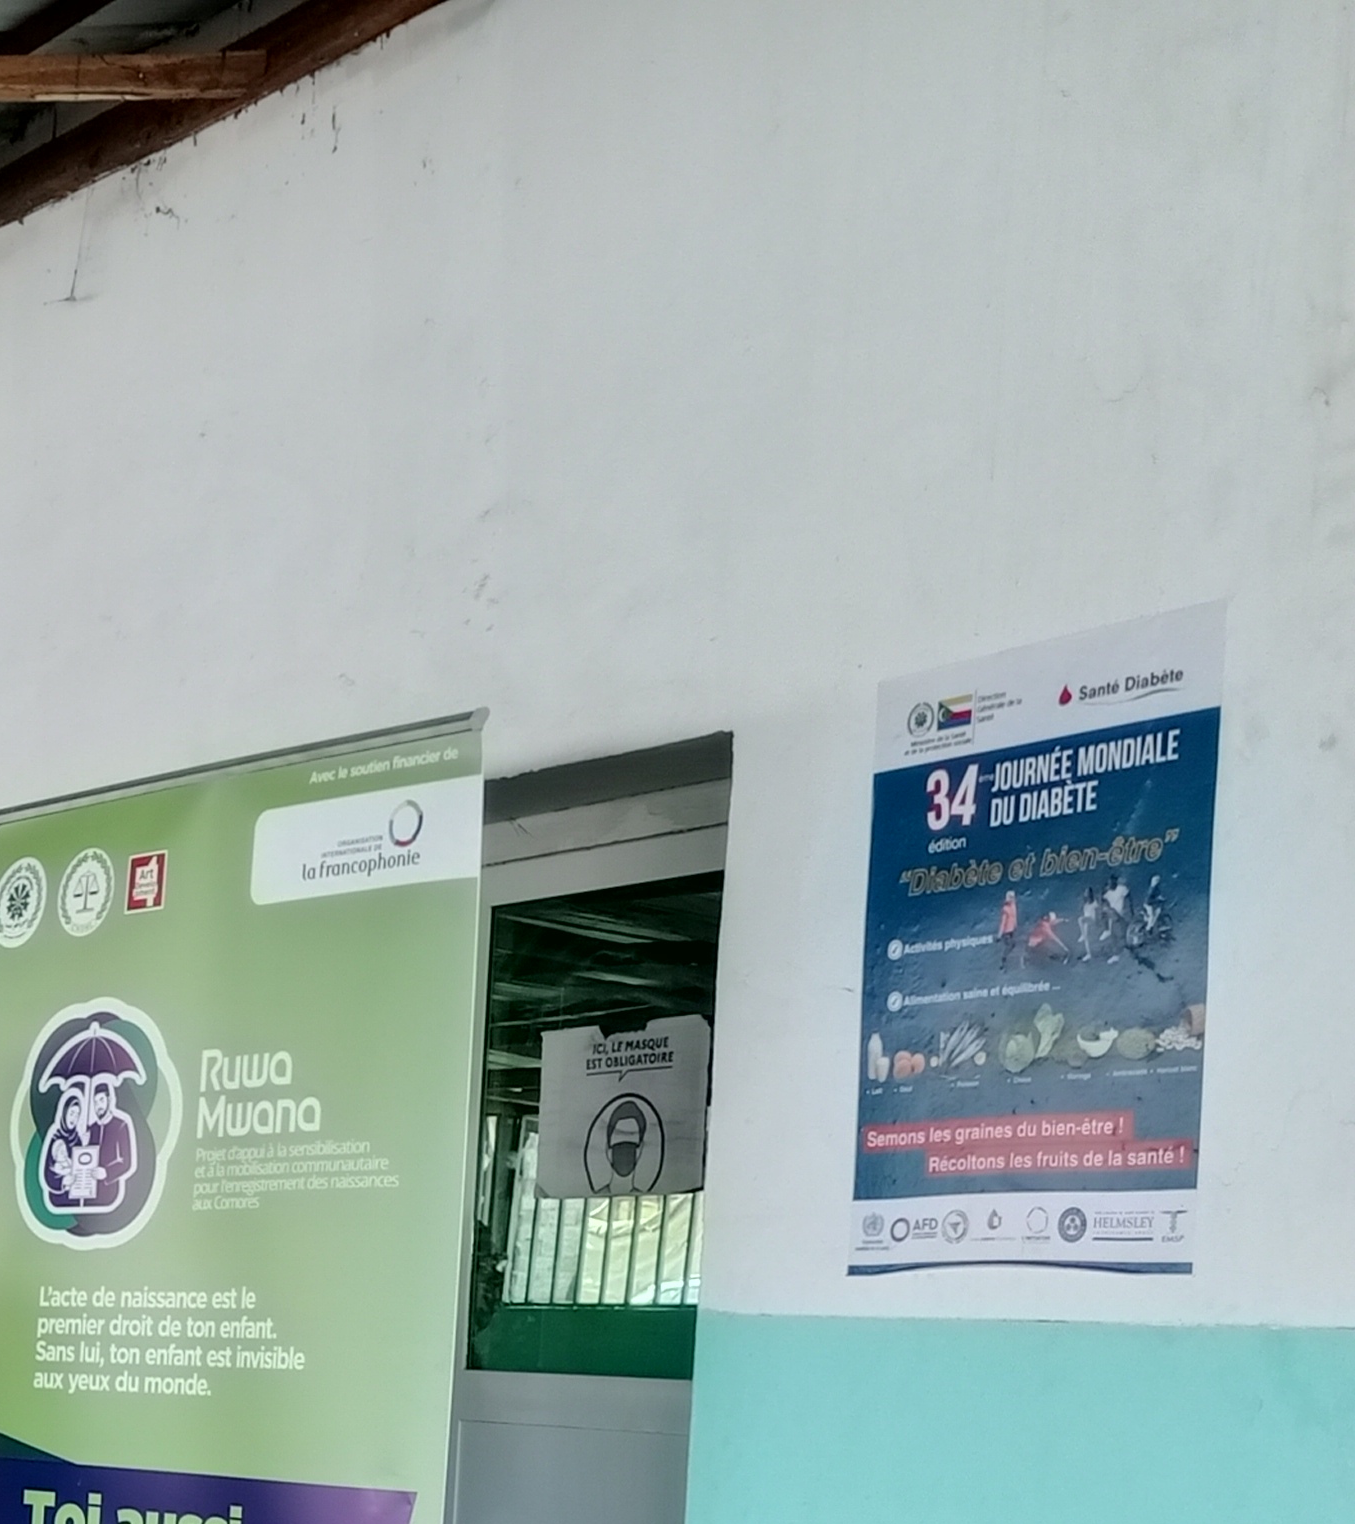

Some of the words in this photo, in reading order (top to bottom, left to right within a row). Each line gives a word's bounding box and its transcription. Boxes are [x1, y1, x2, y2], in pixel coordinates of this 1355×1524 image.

[1078, 680, 1120, 701] Santé
[1124, 668, 1185, 692] Diabète
[309, 770, 335, 785] Avec
[338, 766, 348, 779] le
[350, 759, 390, 778] soutien
[393, 750, 441, 769] financier
[443, 747, 459, 761] de
[925, 764, 979, 831] 34
[991, 745, 1074, 793] JOURNÉE
[1077, 729, 1181, 777] MONDIALE
[990, 796, 1016, 827] DU
[1018, 780, 1099, 823] DIABÈTE
[928, 836, 967, 854] édition
[139, 869, 154, 879] Art
[302, 863, 316, 881] la
[319, 849, 421, 877] francophonie
[1008, 852, 1035, 881] et
[903, 940, 942, 955] Activités
[944, 934, 993, 951] physiques
[903, 990, 961, 1006] Alimentation
[963, 988, 989, 1000] saine
[990, 986, 999, 997] et
[1001, 981, 1050, 997] équilibrée
[592, 1042, 609, 1055] ICI,
[611, 1040, 624, 1053] LE
[625, 1036, 669, 1051] MASQUE
[199, 1048, 293, 1093] Ruwa
[586, 1058, 602, 1070] EST
[605, 1051, 674, 1068] OBLIGATOIRE
[196, 1094, 322, 1139] Mwana
[867, 1131, 925, 1147] Semons
[929, 1127, 951, 1142] les
[955, 1123, 1012, 1145] graines
[1017, 1121, 1036, 1137] du
[1042, 1118, 1114, 1136] bien-être
[195, 1147, 226, 1165] Projet
[267, 1143, 274, 1158] à
[277, 1142, 287, 1157] la
[289, 1139, 370, 1157] sensibilisation
[929, 1153, 1005, 1173] Récoltons
[1010, 1152, 1032, 1168] les
[1037, 1150, 1078, 1167] fruits
[1083, 1150, 1103, 1166] de
[1108, 1149, 1122, 1166] la
[1127, 1146, 1174, 1166] santé
[194, 1165, 205, 1179] et
[207, 1162, 215, 1178] à
[216, 1163, 225, 1177] la
[227, 1160, 290, 1176] mobilisation
[291, 1156, 389, 1174] communautaire
[193, 1181, 219, 1198] pour
[307, 1175, 328, 1190] des
[330, 1173, 399, 1189] naissances
[192, 1199, 212, 1211] aux
[214, 1196, 260, 1210] Comores
[912, 1217, 938, 1231] AFD
[1093, 1217, 1155, 1229] HELMSLEY
[92, 1286, 116, 1308] de
[121, 1286, 208, 1309] naissance
[211, 1287, 237, 1309] est
[241, 1286, 256, 1309] le
[37, 1313, 105, 1338] premier
[109, 1314, 154, 1337] droit
[158, 1315, 181, 1337] de
[187, 1317, 215, 1338] ton
[220, 1315, 277, 1339] enfant.
[35, 1340, 75, 1362] Sans
[79, 1341, 105, 1368] lui,
[110, 1343, 140, 1365] ton
[145, 1343, 202, 1366] enfant
[206, 1346, 232, 1368] est
[236, 1345, 305, 1370] invisible
[33, 1371, 64, 1389] aux
[68, 1372, 110, 1394] yeux
[115, 1370, 139, 1393] du
[144, 1373, 212, 1396] monde.
